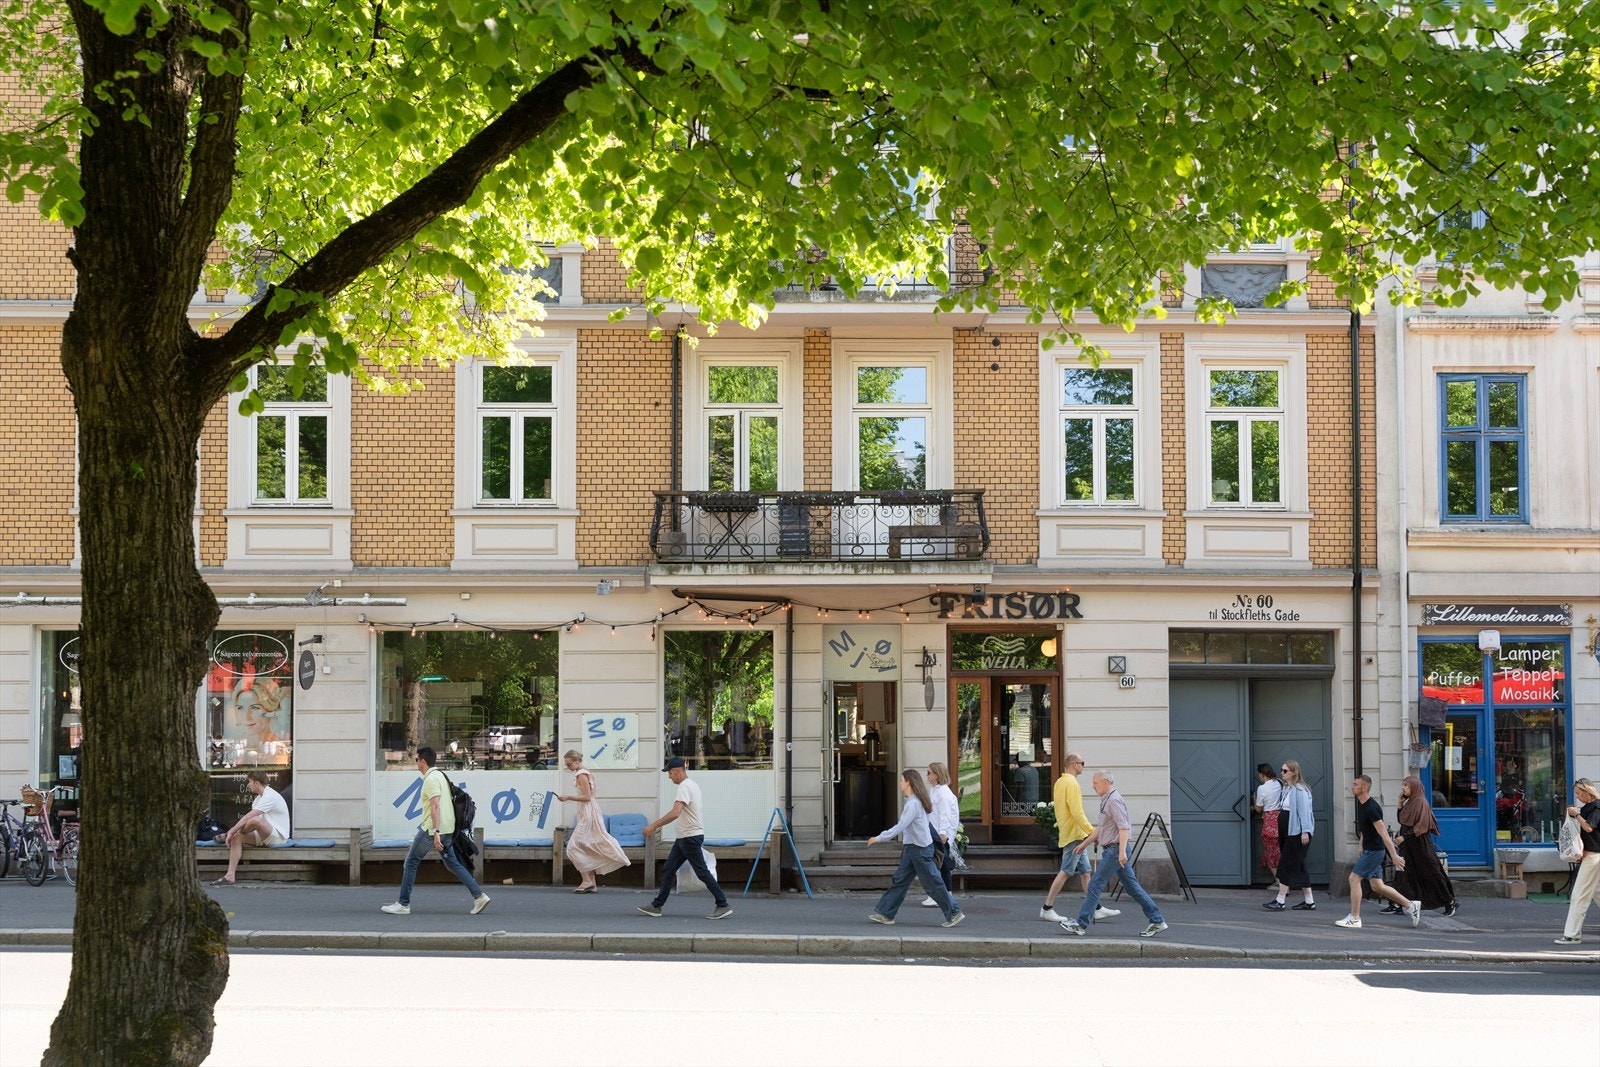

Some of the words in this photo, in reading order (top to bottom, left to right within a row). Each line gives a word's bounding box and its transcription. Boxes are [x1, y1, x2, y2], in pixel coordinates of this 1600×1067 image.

[930, 592, 1083, 620] FRISØR
[1257, 594, 1274, 608] 60
[1221, 608, 1271, 621] Stockfleths
[1274, 609, 1300, 621] Gade
[1431, 604, 1567, 623] Lillemedina.no
[981, 655, 1027, 670] WELLA
[1498, 646, 1560, 665] Lamper
[1121, 676, 1134, 687] 60
[1430, 671, 1480, 686] Puffer
[1500, 667, 1560, 683] Tepper
[1500, 687, 1560, 701] Mosaikk
[1002, 801, 1037, 813] REDK
